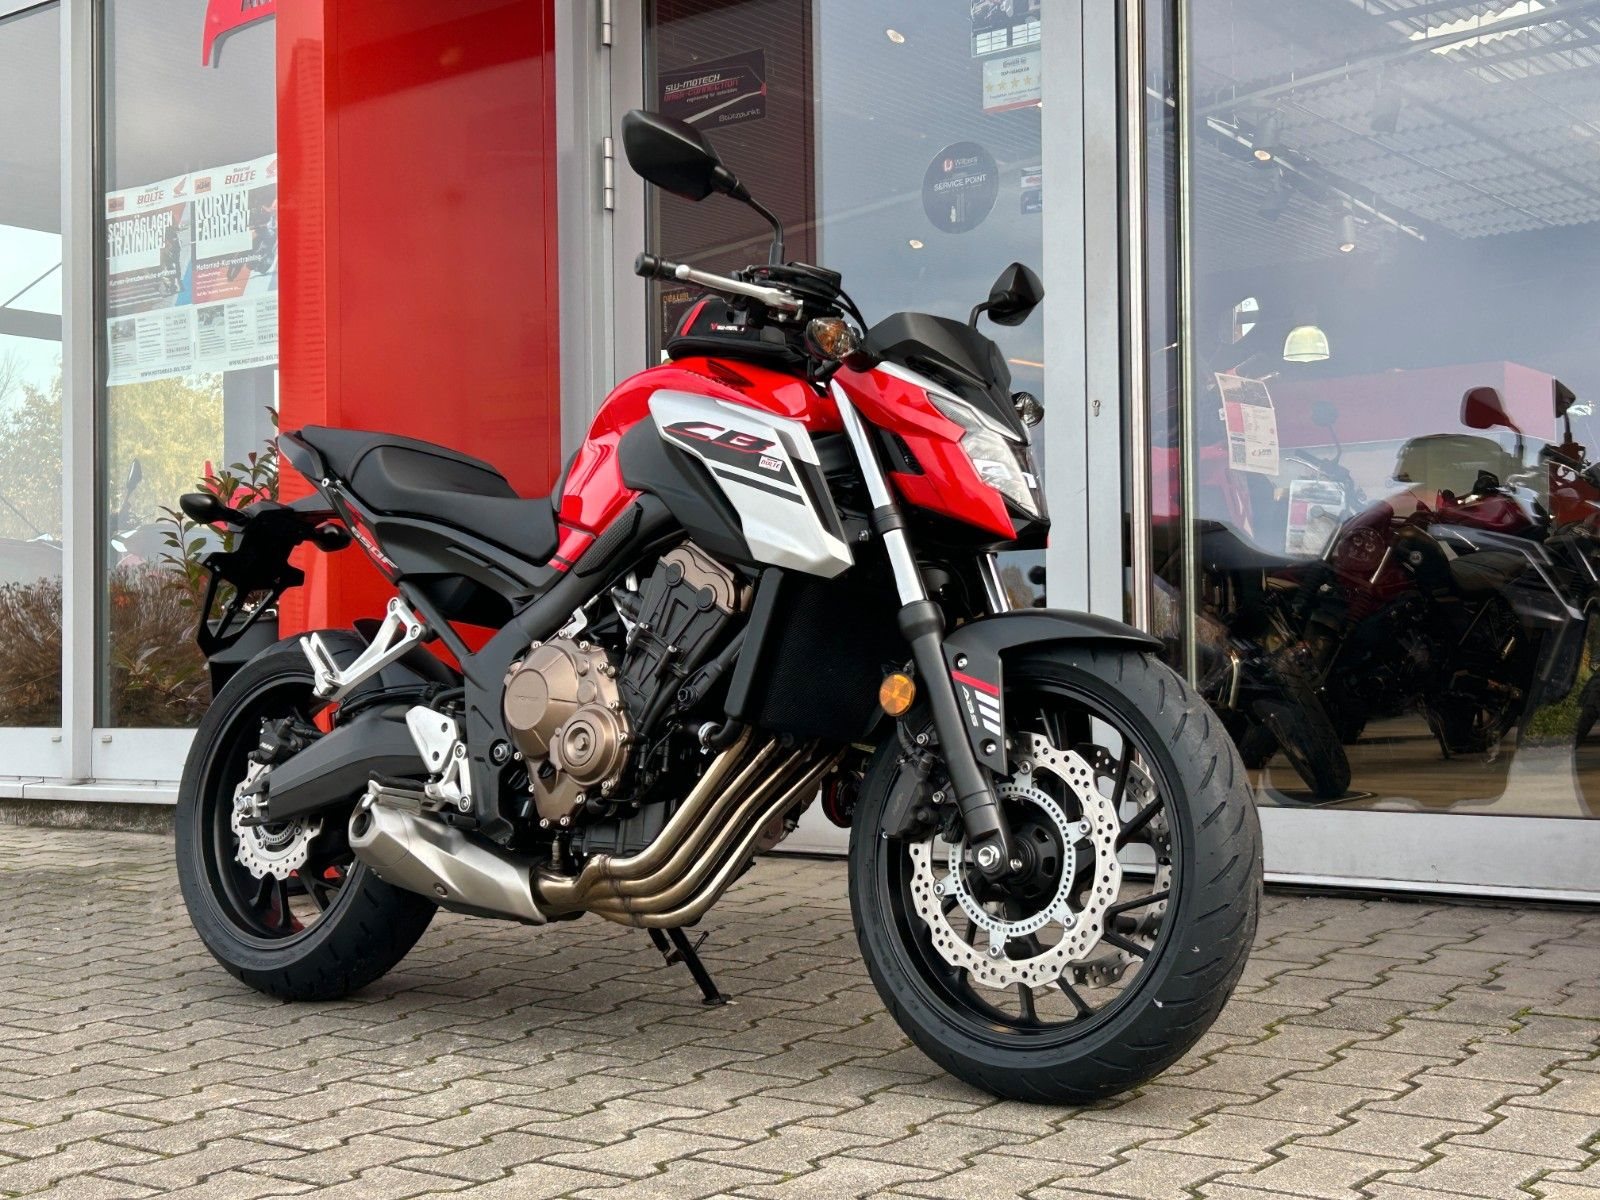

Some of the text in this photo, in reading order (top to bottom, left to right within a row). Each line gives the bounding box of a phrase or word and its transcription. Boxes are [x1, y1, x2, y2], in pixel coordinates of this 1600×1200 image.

[665, 74, 720, 92] SW-MOTECH
[224, 170, 256, 185] BOLTE
[934, 178, 964, 192] SERVICE
[965, 173, 987, 185] POINT
[137, 191, 164, 205] BOLTE
[195, 190, 249, 221] KURVEN
[108, 211, 173, 237] SCHRÄGLAGEN
[195, 210, 251, 241] FAHREN!
[108, 223, 166, 257] TRAINING!
[662, 421, 777, 454] CB
